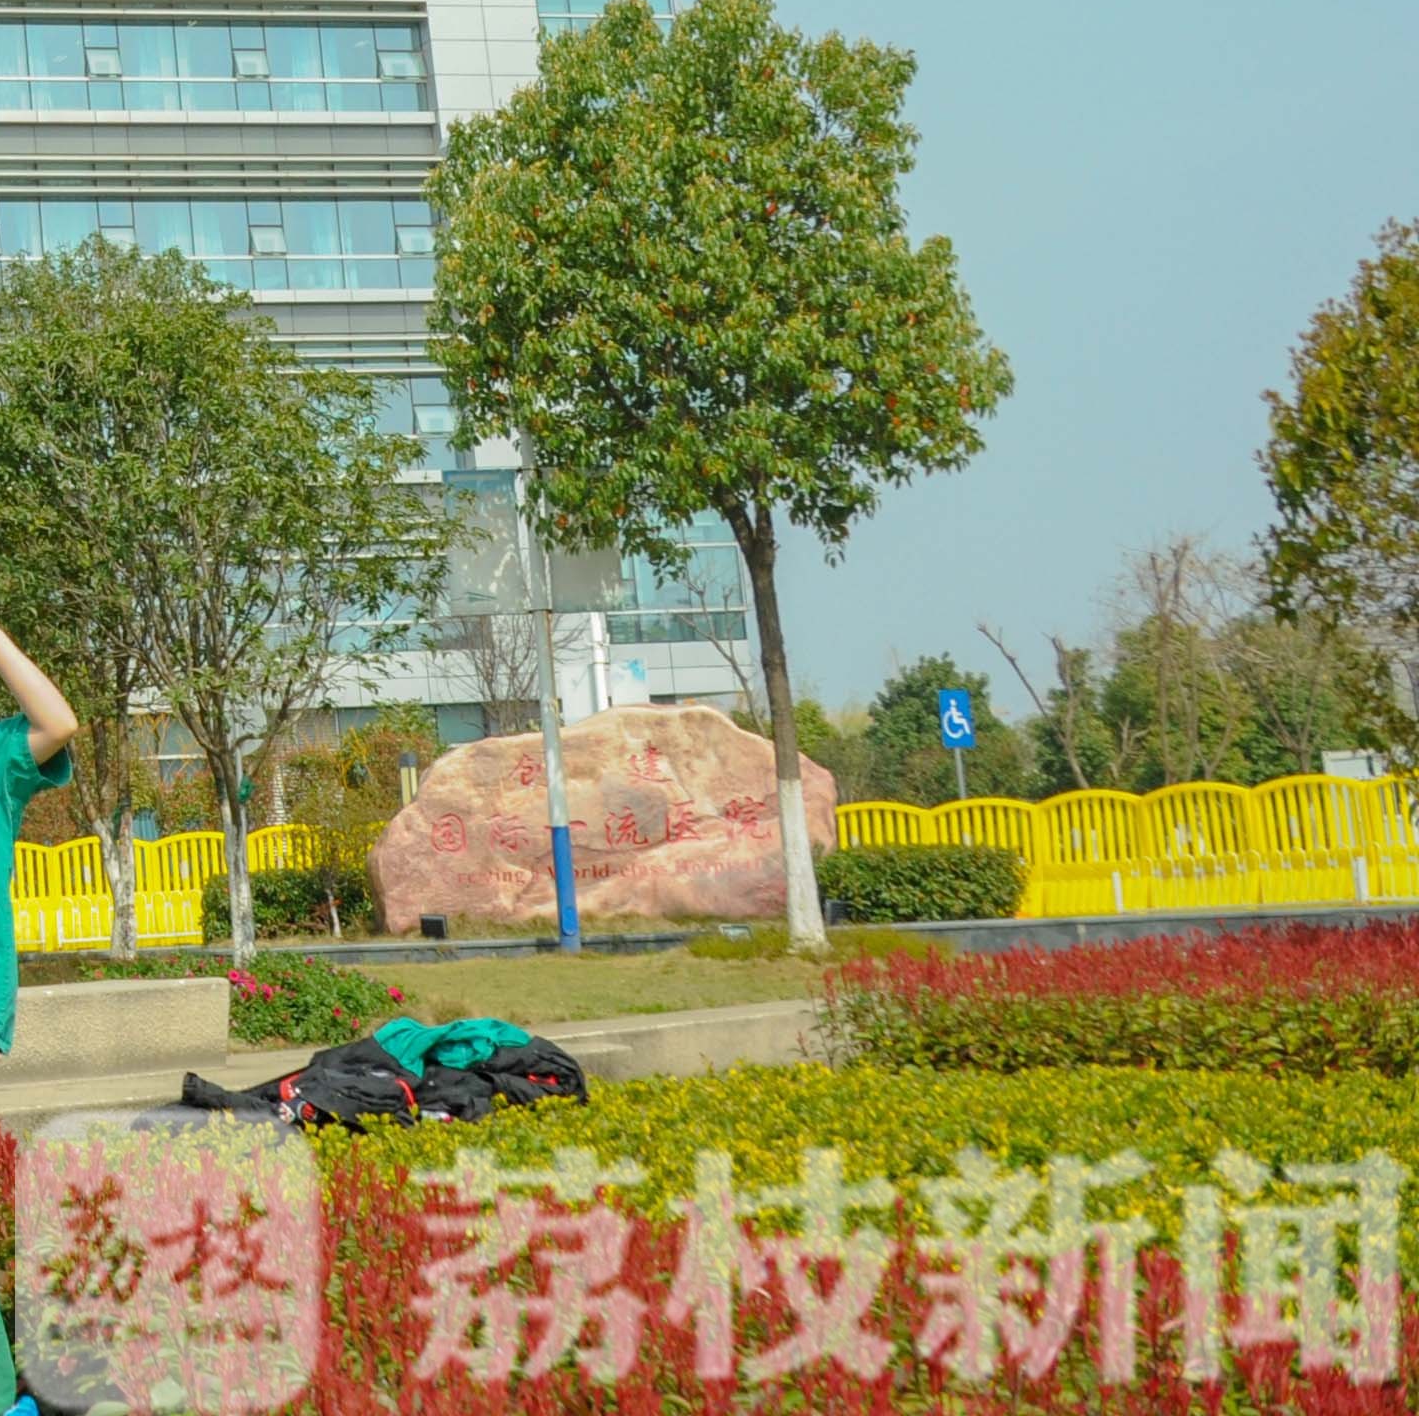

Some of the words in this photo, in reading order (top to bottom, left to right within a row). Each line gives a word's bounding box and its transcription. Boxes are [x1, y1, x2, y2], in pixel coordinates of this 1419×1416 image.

[431, 797, 771, 854] 国际一流医院
